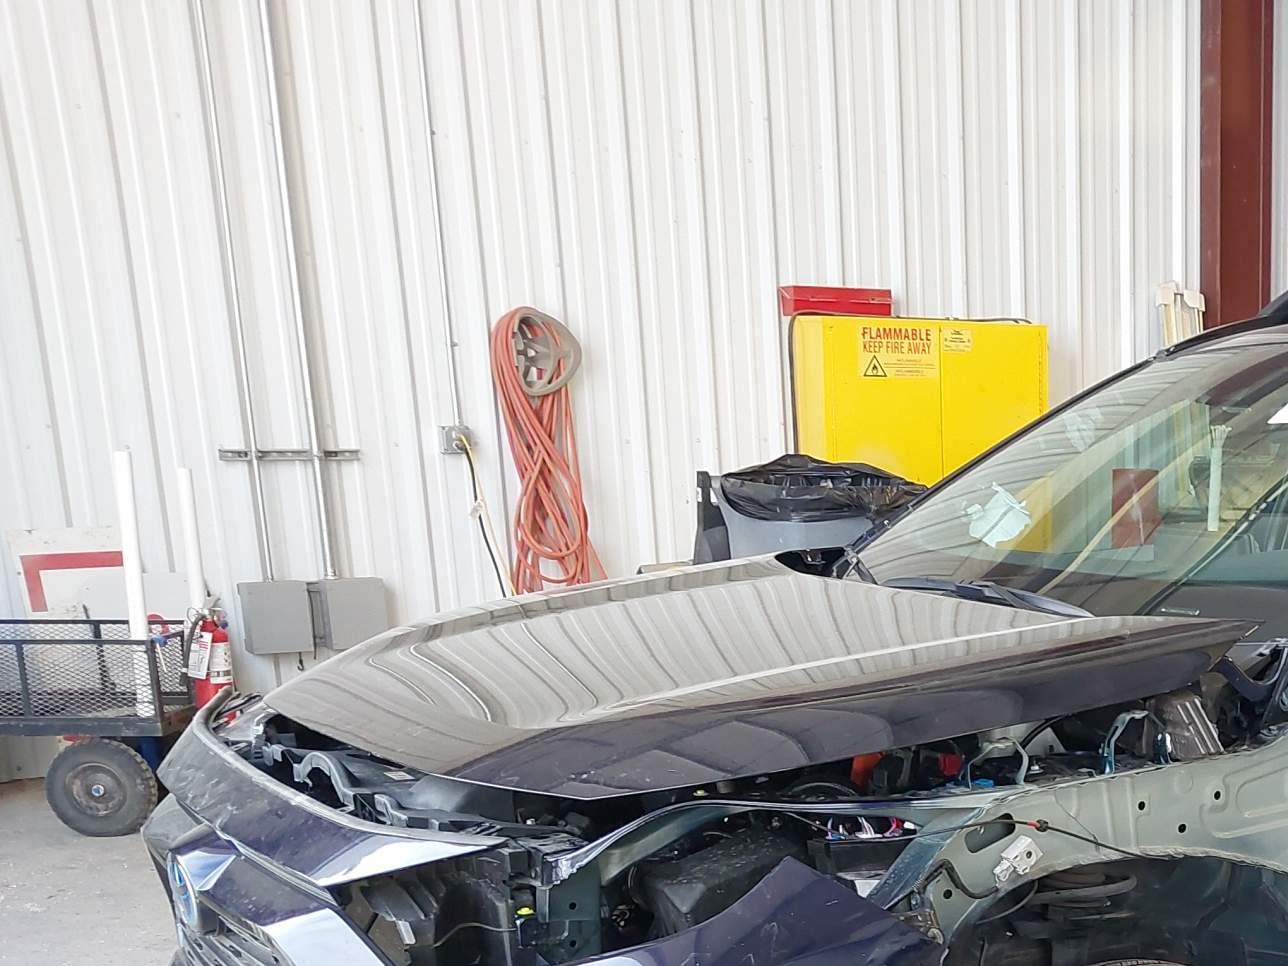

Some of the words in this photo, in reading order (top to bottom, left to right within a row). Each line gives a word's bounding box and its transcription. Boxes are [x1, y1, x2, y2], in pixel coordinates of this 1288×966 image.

[861, 327, 932, 342] FLAMMABLE
[862, 341, 884, 354] KEEP
[886, 341, 905, 355] FIRE
[907, 342, 932, 355] AWAY
